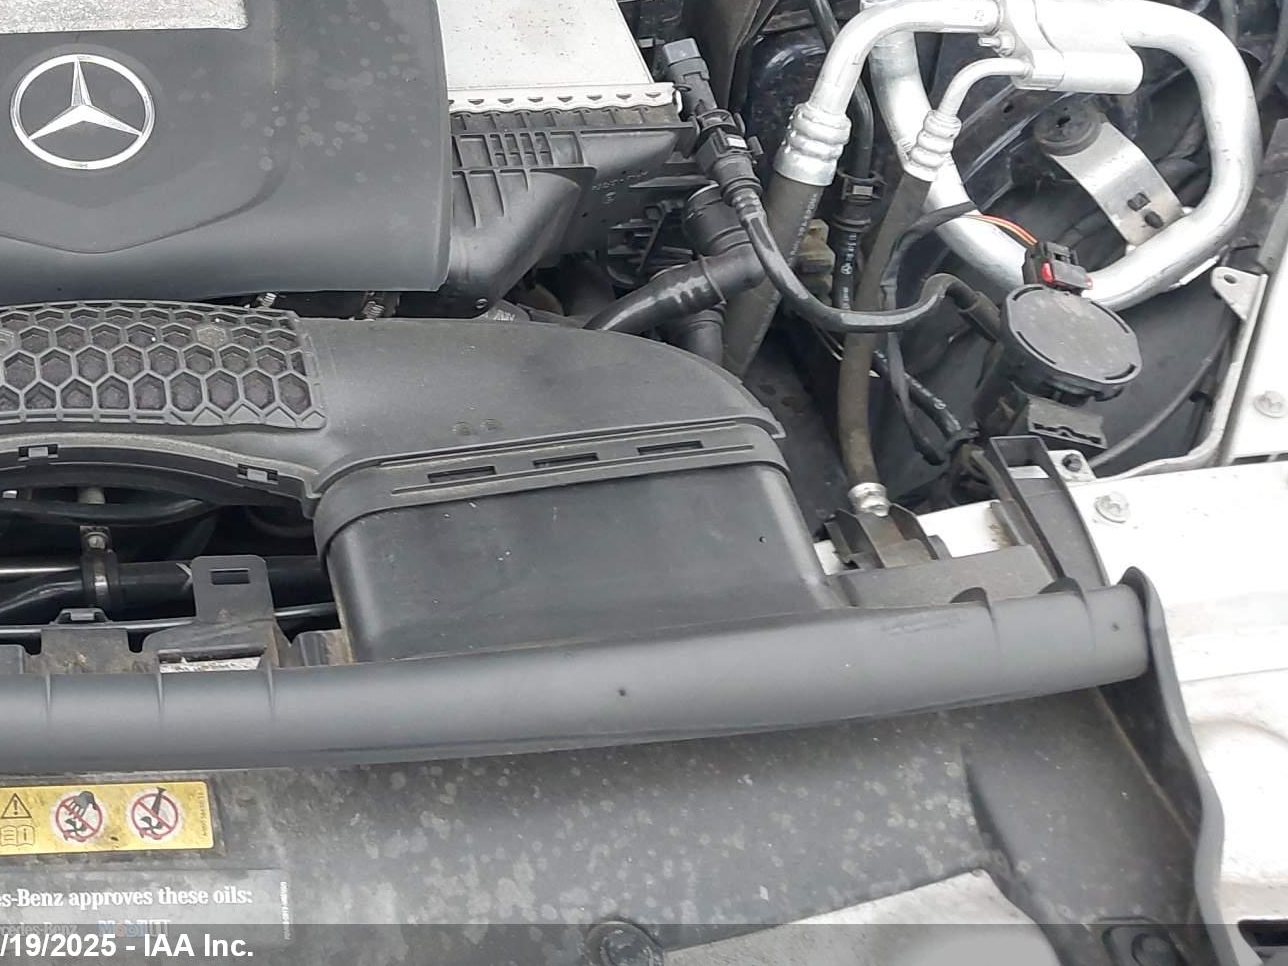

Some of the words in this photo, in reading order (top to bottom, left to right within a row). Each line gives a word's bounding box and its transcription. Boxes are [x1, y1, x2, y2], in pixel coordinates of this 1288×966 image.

[68, 889, 153, 910] approves
[158, 886, 209, 905] these
[213, 885, 254, 904] oils:
